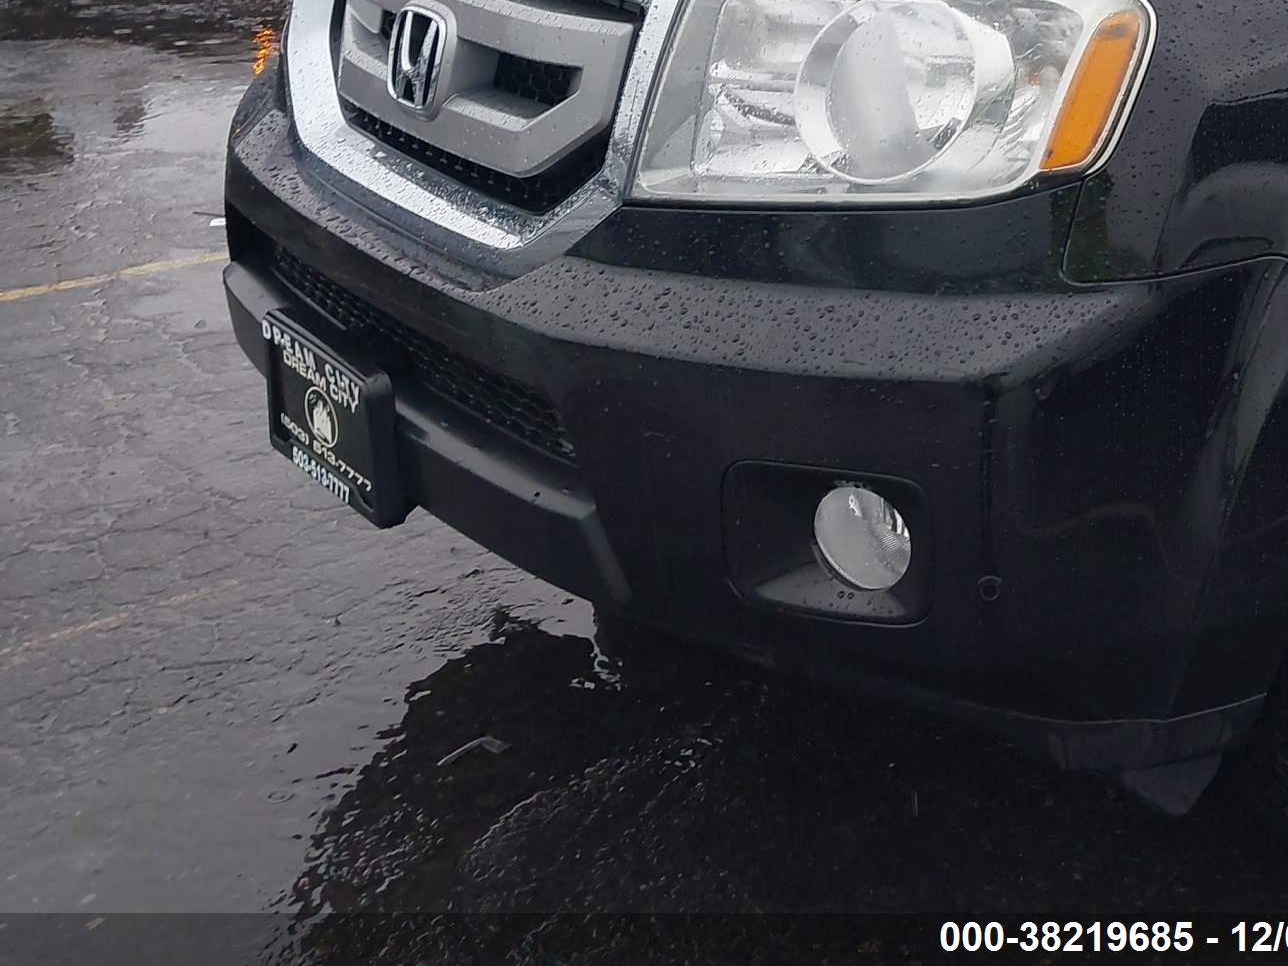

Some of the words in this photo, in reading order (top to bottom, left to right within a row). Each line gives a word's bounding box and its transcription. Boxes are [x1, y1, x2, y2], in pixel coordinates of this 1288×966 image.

[262, 319, 317, 371] DREAM
[325, 362, 360, 404] CITY
[283, 351, 327, 392] DREAM
[292, 445, 350, 504] 503-513-7777
